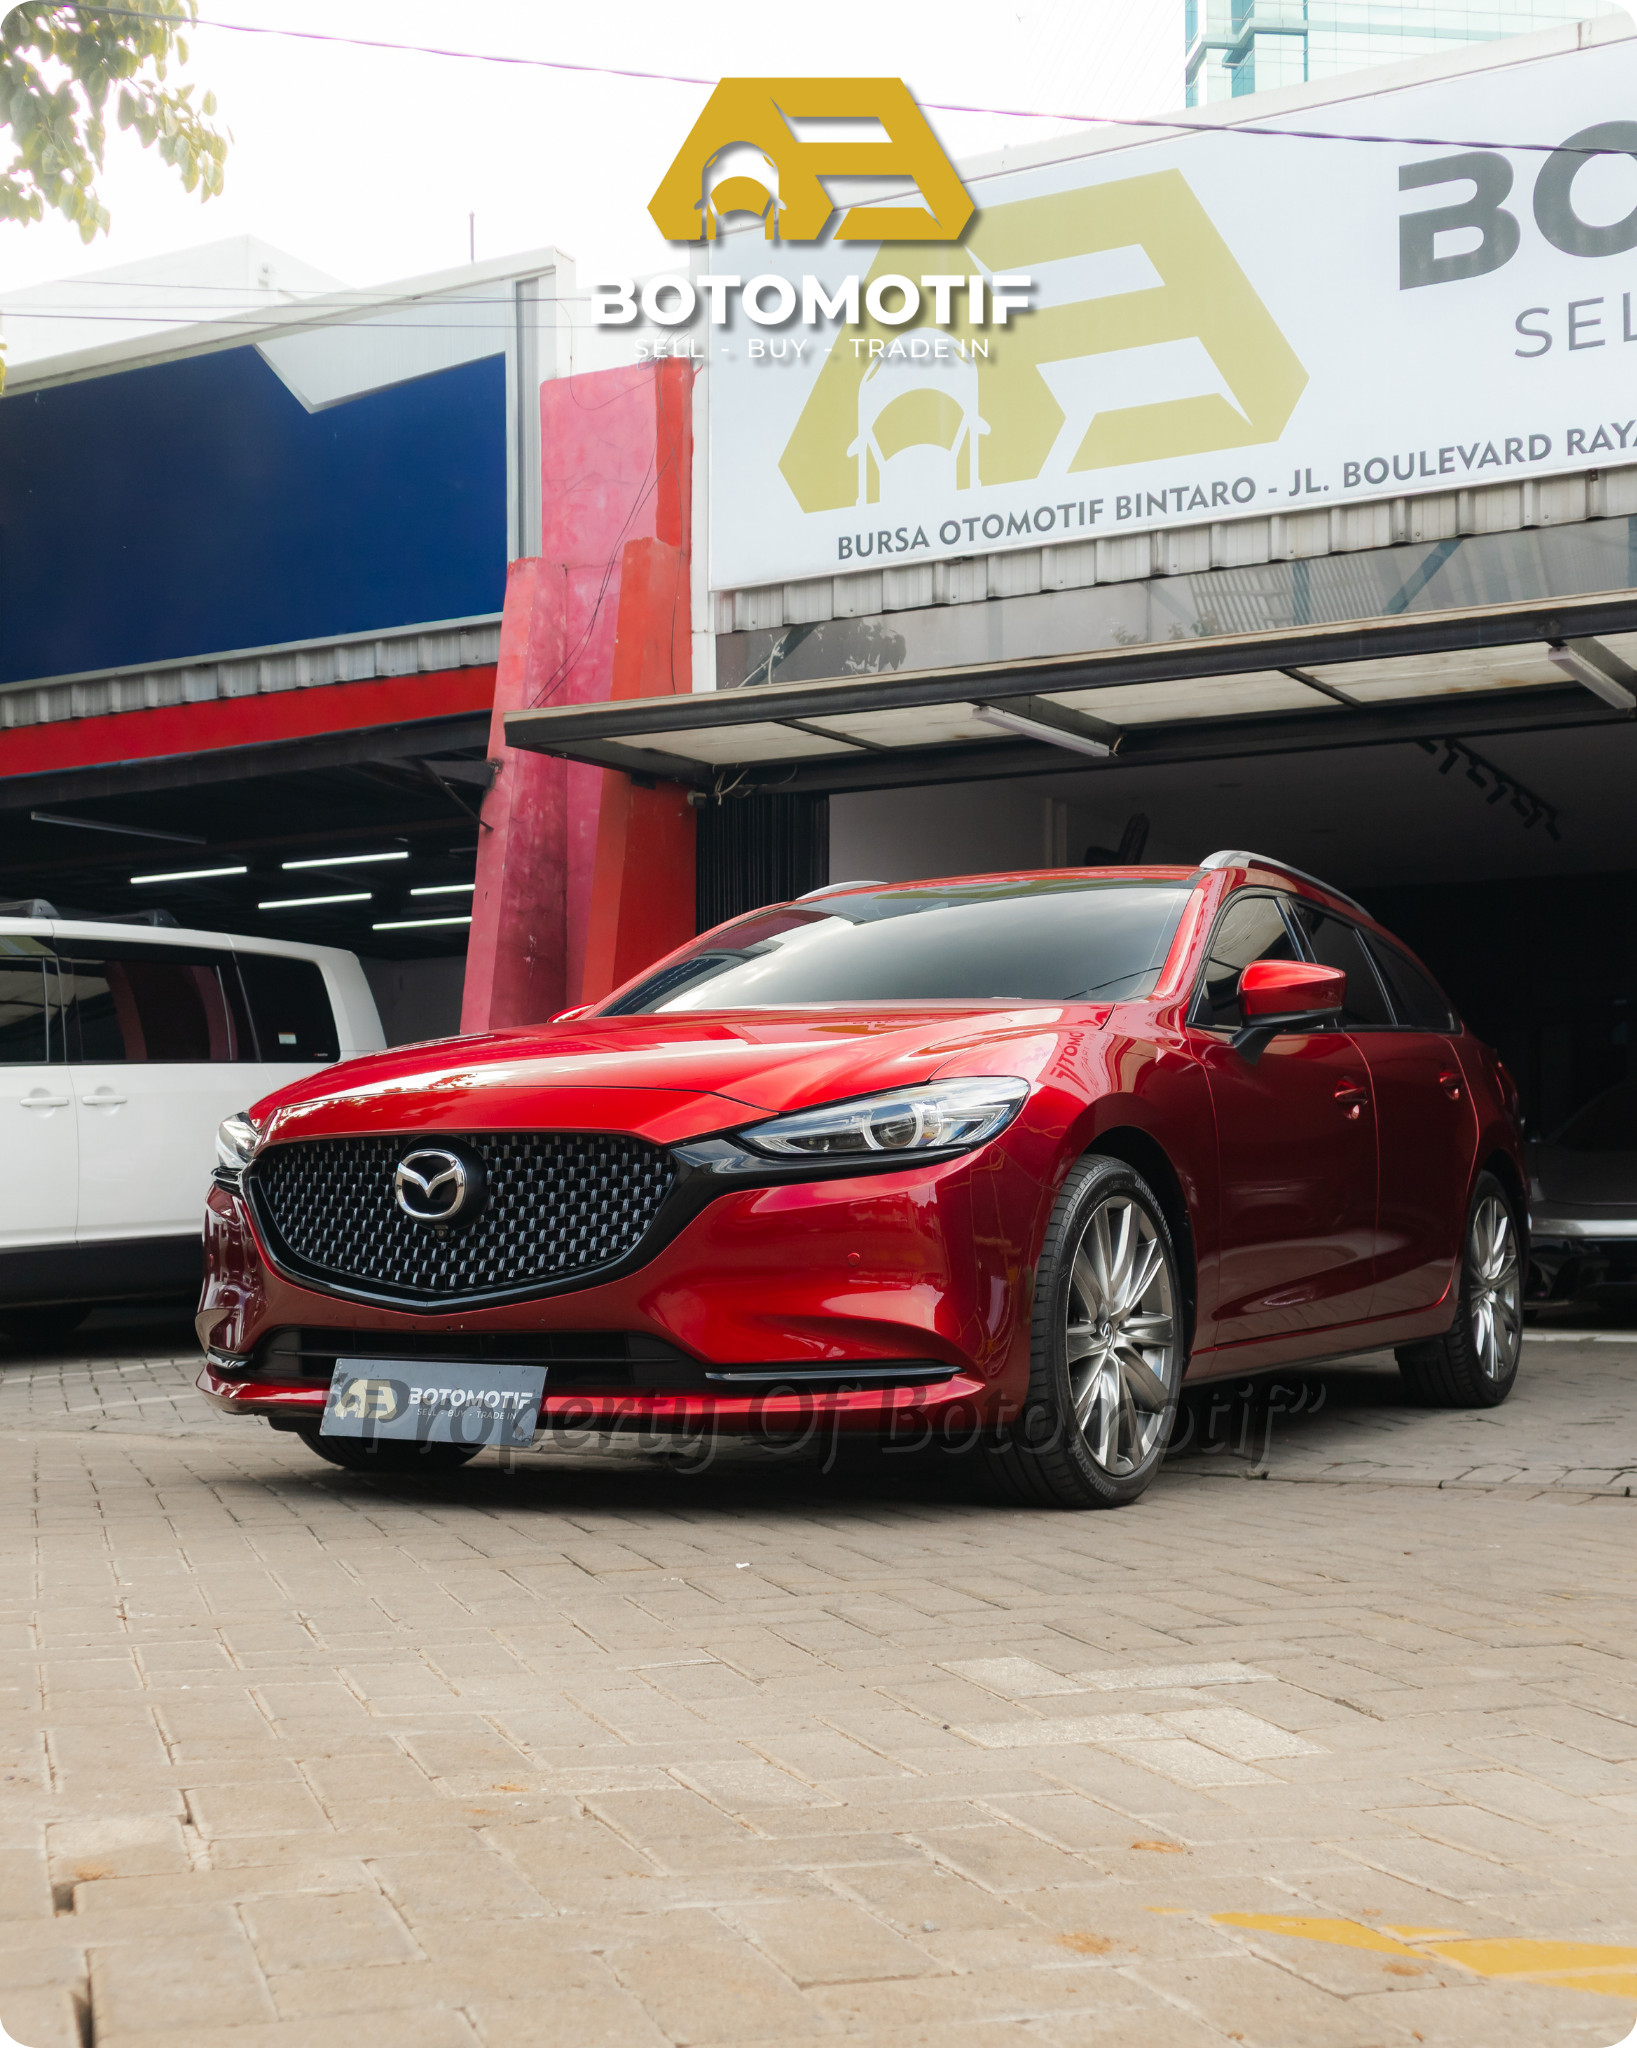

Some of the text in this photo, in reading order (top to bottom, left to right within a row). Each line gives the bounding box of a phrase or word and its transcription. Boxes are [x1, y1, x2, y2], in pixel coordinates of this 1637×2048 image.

[838, 525, 930, 560] BURSA
[939, 499, 1103, 545] OTOMOTIF
[1116, 476, 1256, 521] BINTARO
[1289, 468, 1329, 497] JL.
[1343, 433, 1552, 489] BOULEVARD
[1566, 420, 1637, 457] RAY
[408, 1387, 533, 1409] BOTOMOTIF
